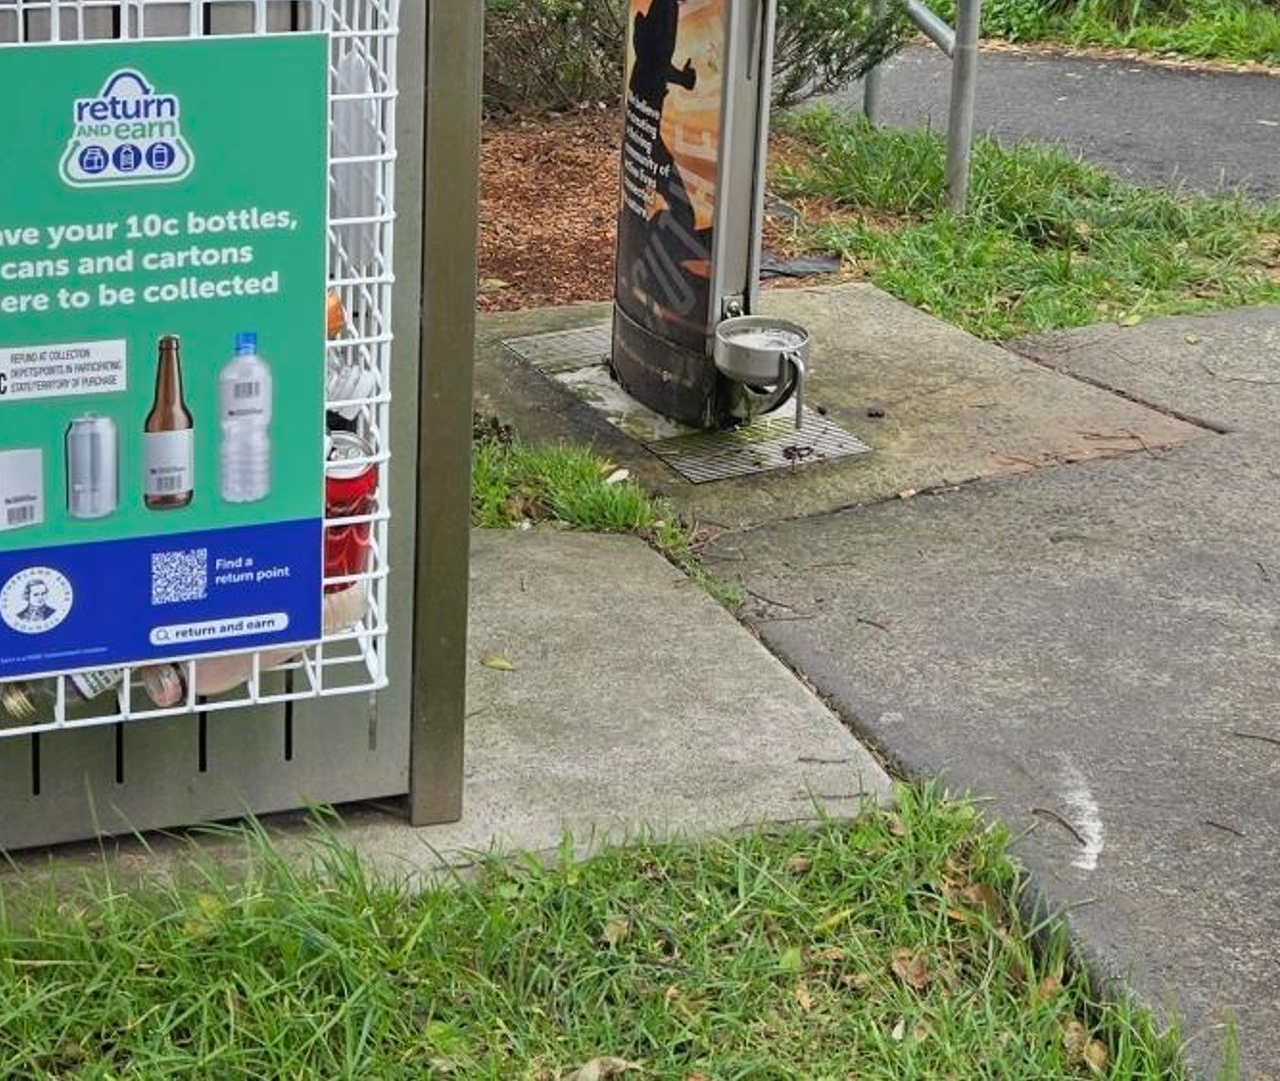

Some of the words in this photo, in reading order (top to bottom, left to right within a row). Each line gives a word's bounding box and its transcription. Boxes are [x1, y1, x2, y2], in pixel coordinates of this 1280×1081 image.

[77, 96, 176, 122] return
[77, 123, 112, 138] AND
[114, 121, 176, 140] earn
[46, 222, 119, 250] your
[125, 214, 180, 239] 10c
[186, 207, 298, 235] bottles,
[0, 258, 70, 281] cans
[77, 249, 134, 275] and
[142, 245, 254, 270] cartons
[57, 287, 91, 309] to
[98, 283, 136, 307] be
[143, 270, 280, 303] collected
[48, 347, 91, 362] COLLECTION
[215, 556, 243, 571] Find
[244, 557, 254, 567] a
[215, 572, 254, 586] return
[255, 566, 291, 583] point
[175, 626, 217, 639] return
[219, 620, 245, 633] and
[246, 618, 276, 630] earn
